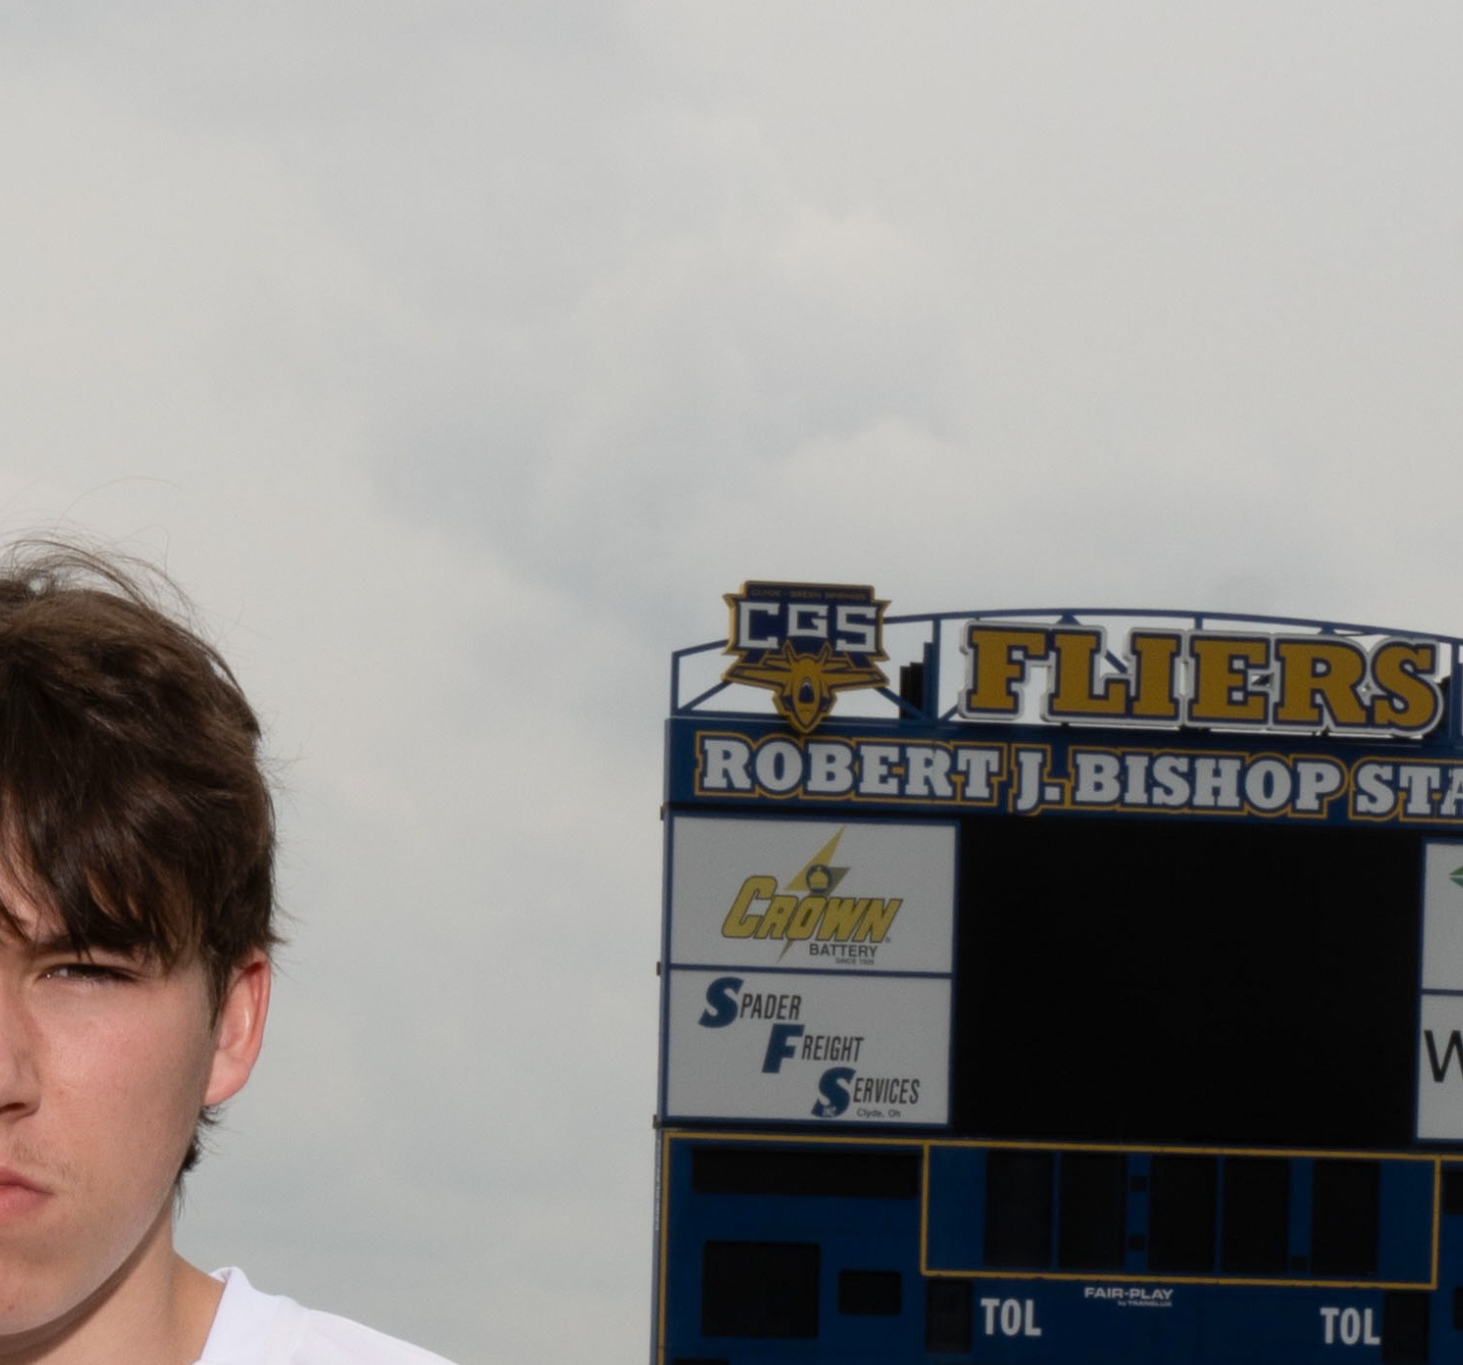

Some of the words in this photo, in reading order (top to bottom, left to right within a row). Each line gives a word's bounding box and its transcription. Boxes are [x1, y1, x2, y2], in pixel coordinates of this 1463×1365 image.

[738, 601, 879, 653] CGS
[962, 621, 1442, 735] FLIERS
[702, 738, 1001, 798] ROBERT
[1015, 750, 1061, 811] J.
[1076, 752, 1342, 811] BISHOP
[721, 875, 904, 943] CROWN
[809, 943, 878, 958] BATTERY
[1084, 1287, 1173, 1300] FAIR-PLAY
[980, 1298, 1042, 1337] TOL
[1320, 1307, 1381, 1346] TOL
